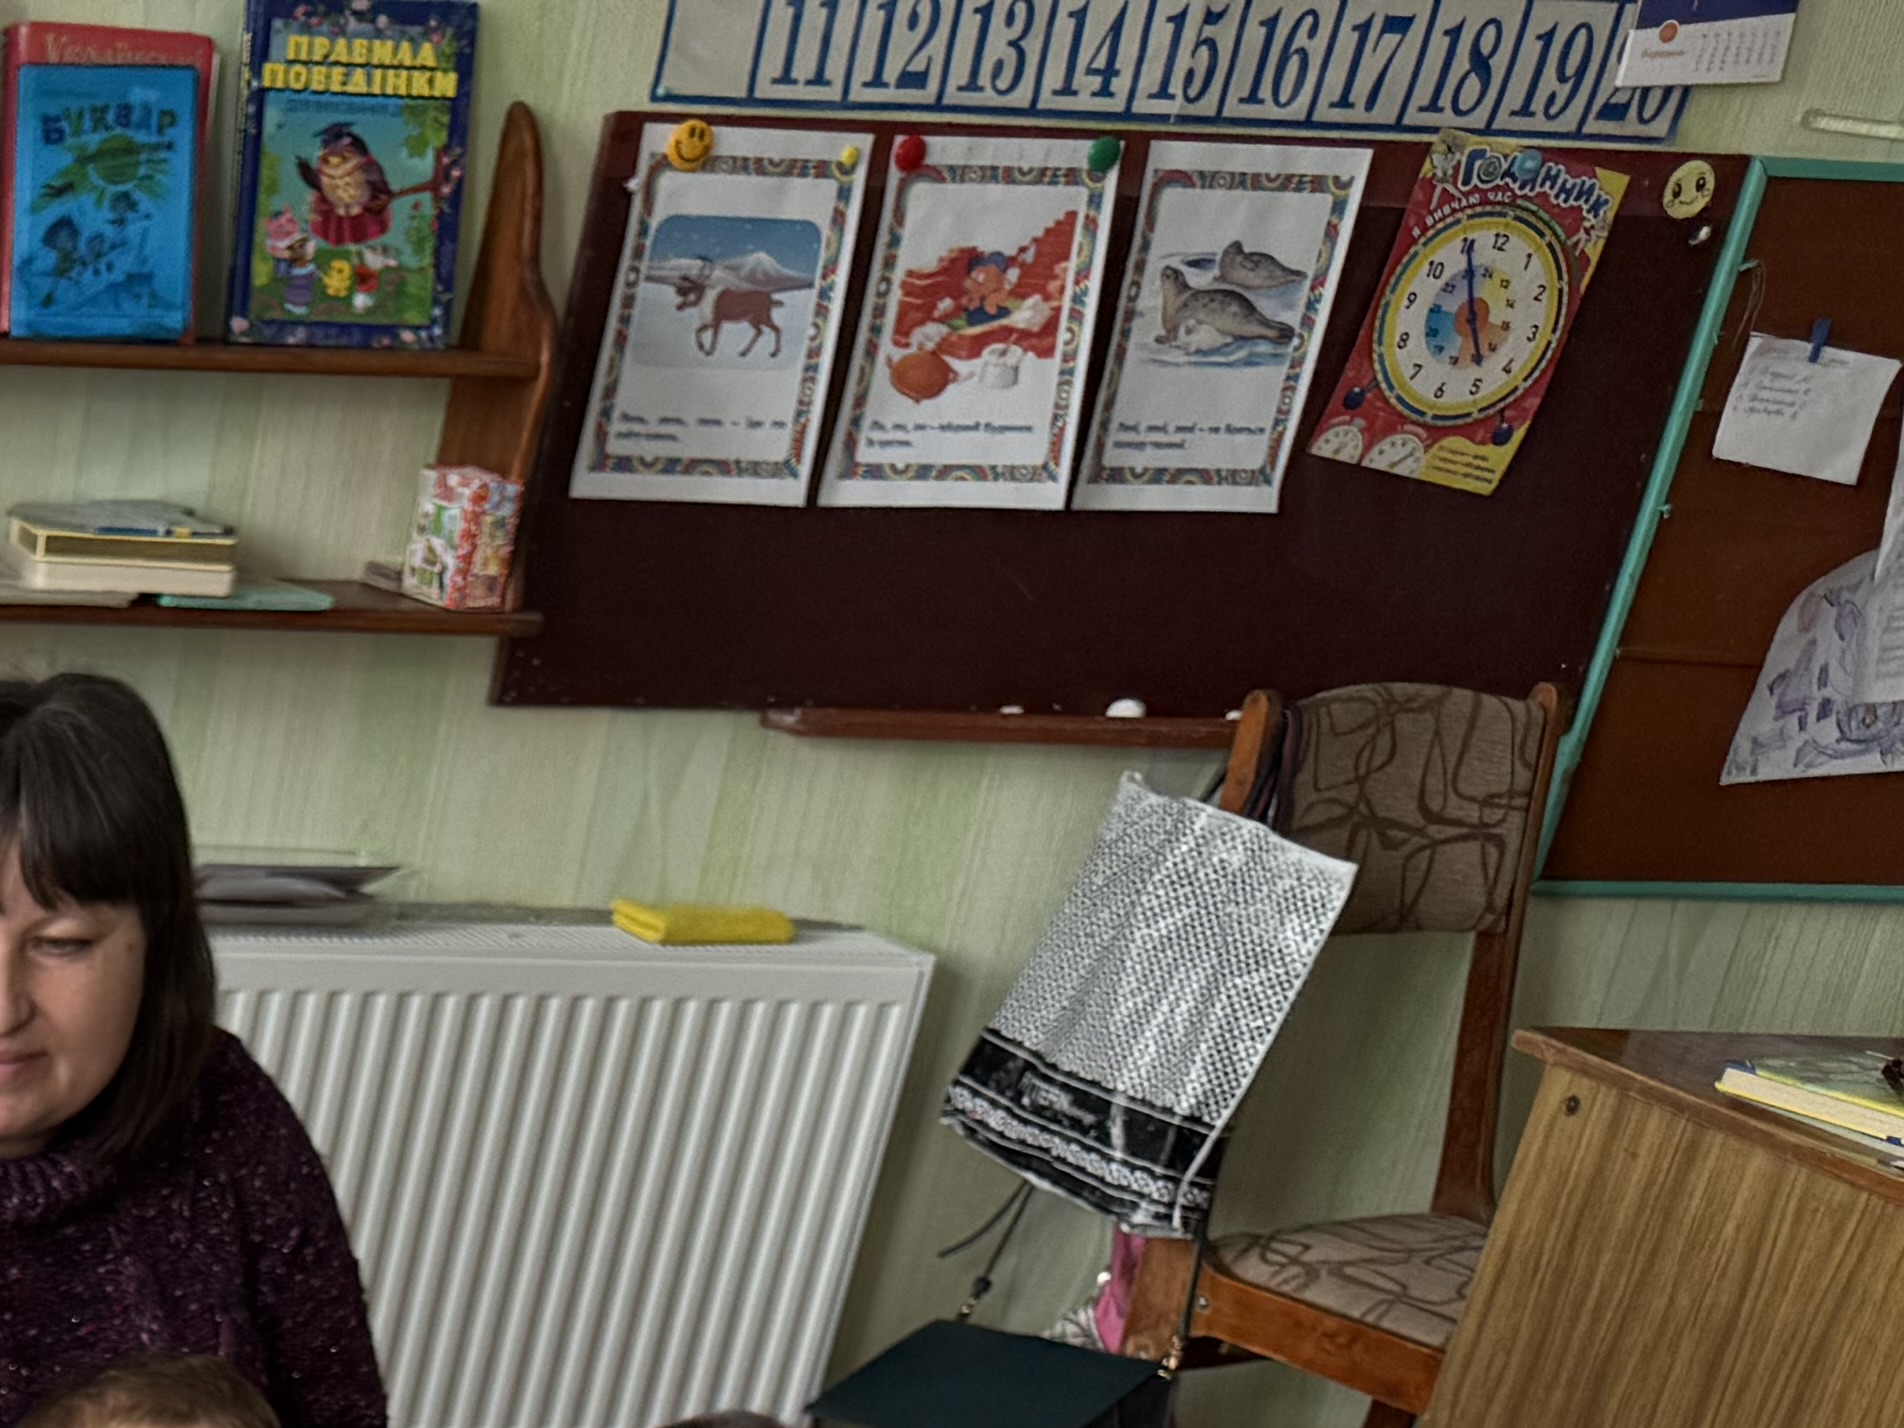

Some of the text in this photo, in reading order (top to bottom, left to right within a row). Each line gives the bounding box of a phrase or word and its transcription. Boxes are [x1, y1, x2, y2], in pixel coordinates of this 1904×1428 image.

[286, 34, 439, 68] ПРАВИЛА
[771, 0, 843, 87] 11
[861, 0, 941, 90] 12
[957, 0, 1035, 96] 13
[1052, 0, 1129, 98] 14
[1147, 3, 1230, 104] 15
[1238, 7, 1320, 109] 16
[1329, 11, 1417, 113] 17
[1417, 16, 1503, 117] 18
[1508, 21, 1594, 121] 19
[261, 62, 459, 98] ПОВЕДІНКИ
[40, 101, 179, 145] БУКВАР
[1487, 191, 1513, 203] ЧАС
[1492, 232, 1509, 252] 12
[1426, 260, 1444, 280] 10
[1523, 252, 1534, 271] 1
[1405, 292, 1418, 309] 9
[1533, 284, 1547, 302] 2
[1396, 332, 1410, 349] 8
[1526, 324, 1540, 342] 3
[1409, 363, 1424, 381] 7
[1501, 358, 1514, 375] 4
[1433, 382, 1447, 399] 6
[1469, 378, 1483, 396] 5
